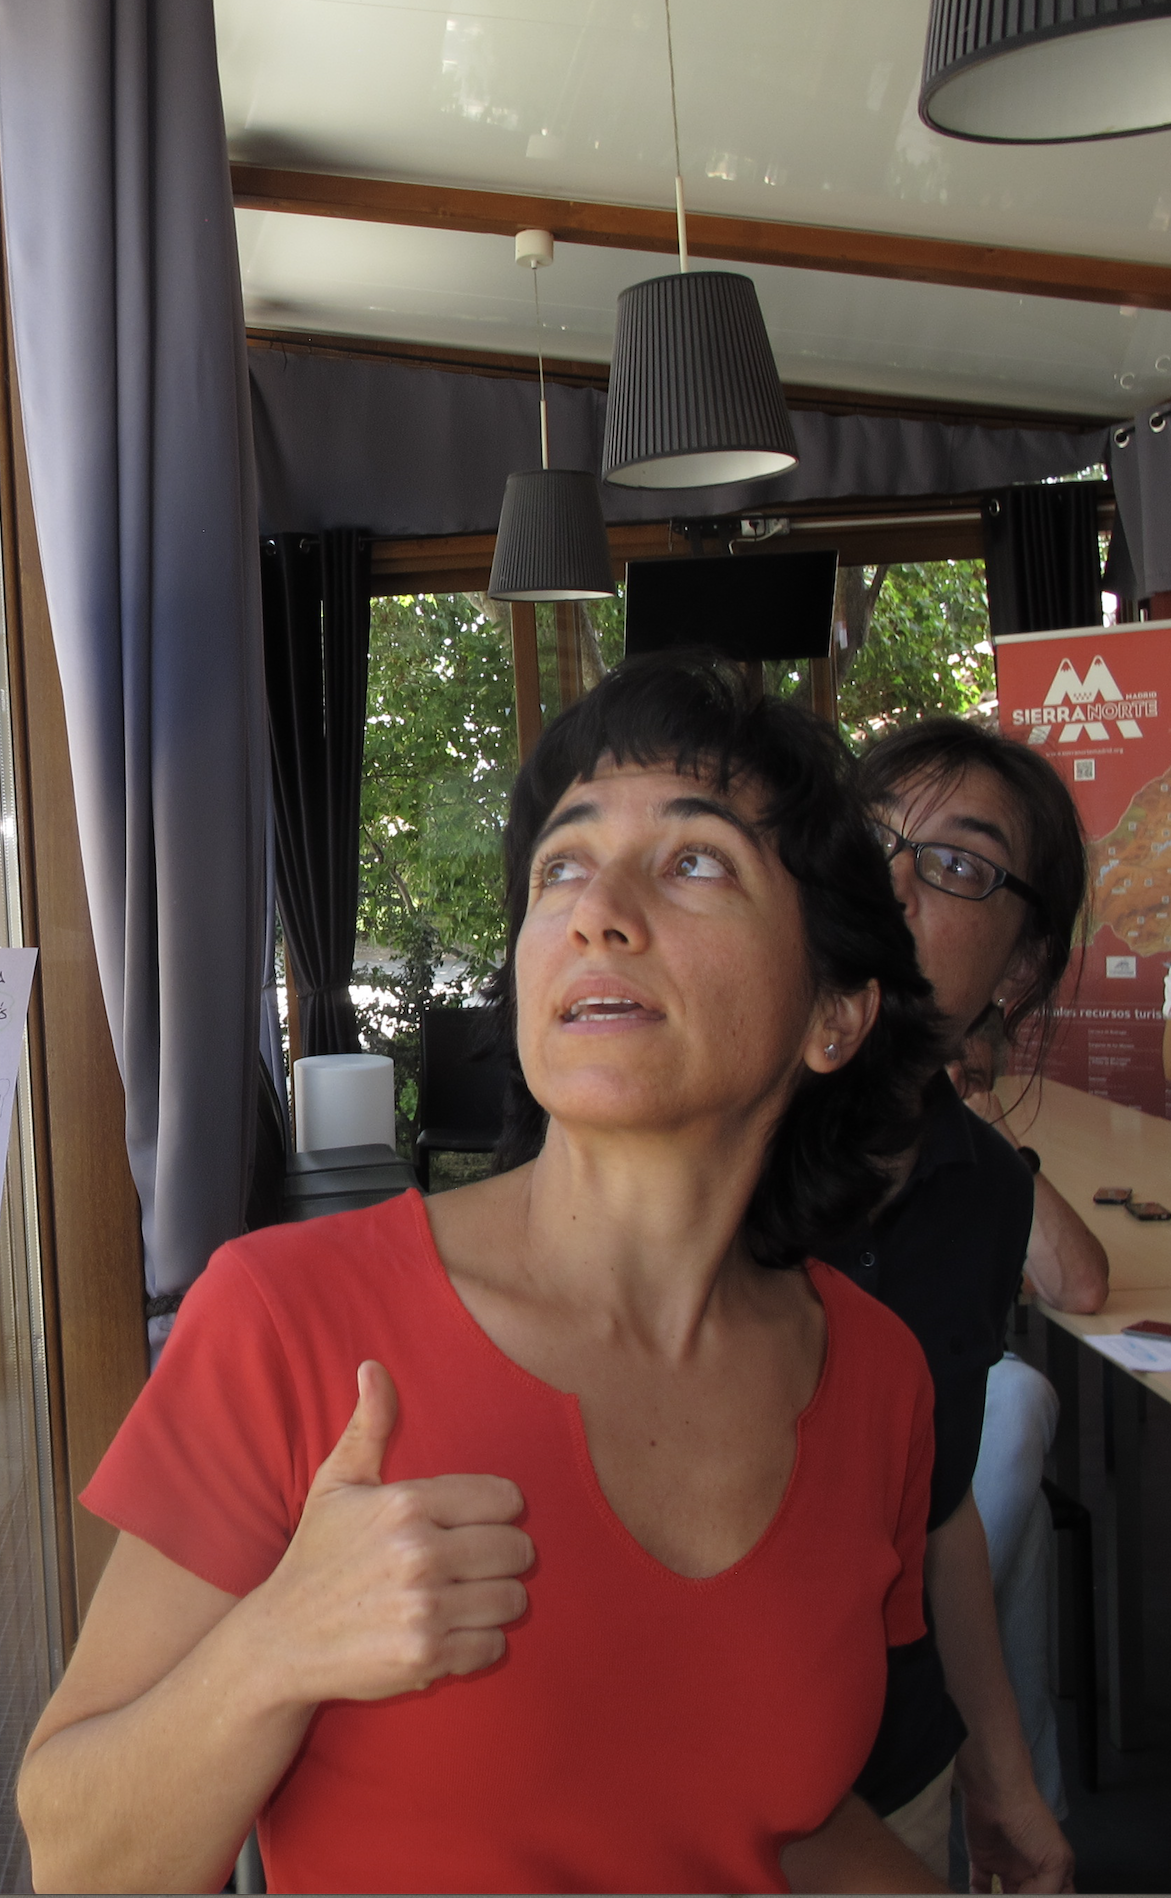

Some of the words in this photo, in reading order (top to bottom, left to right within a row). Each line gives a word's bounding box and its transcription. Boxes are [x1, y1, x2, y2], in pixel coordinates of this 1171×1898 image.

[1126, 691, 1158, 701] MADRID
[1012, 704, 1087, 726] SIERRA
[1087, 699, 1158, 721] NORTE
[1080, 1007, 1131, 1019] recursos
